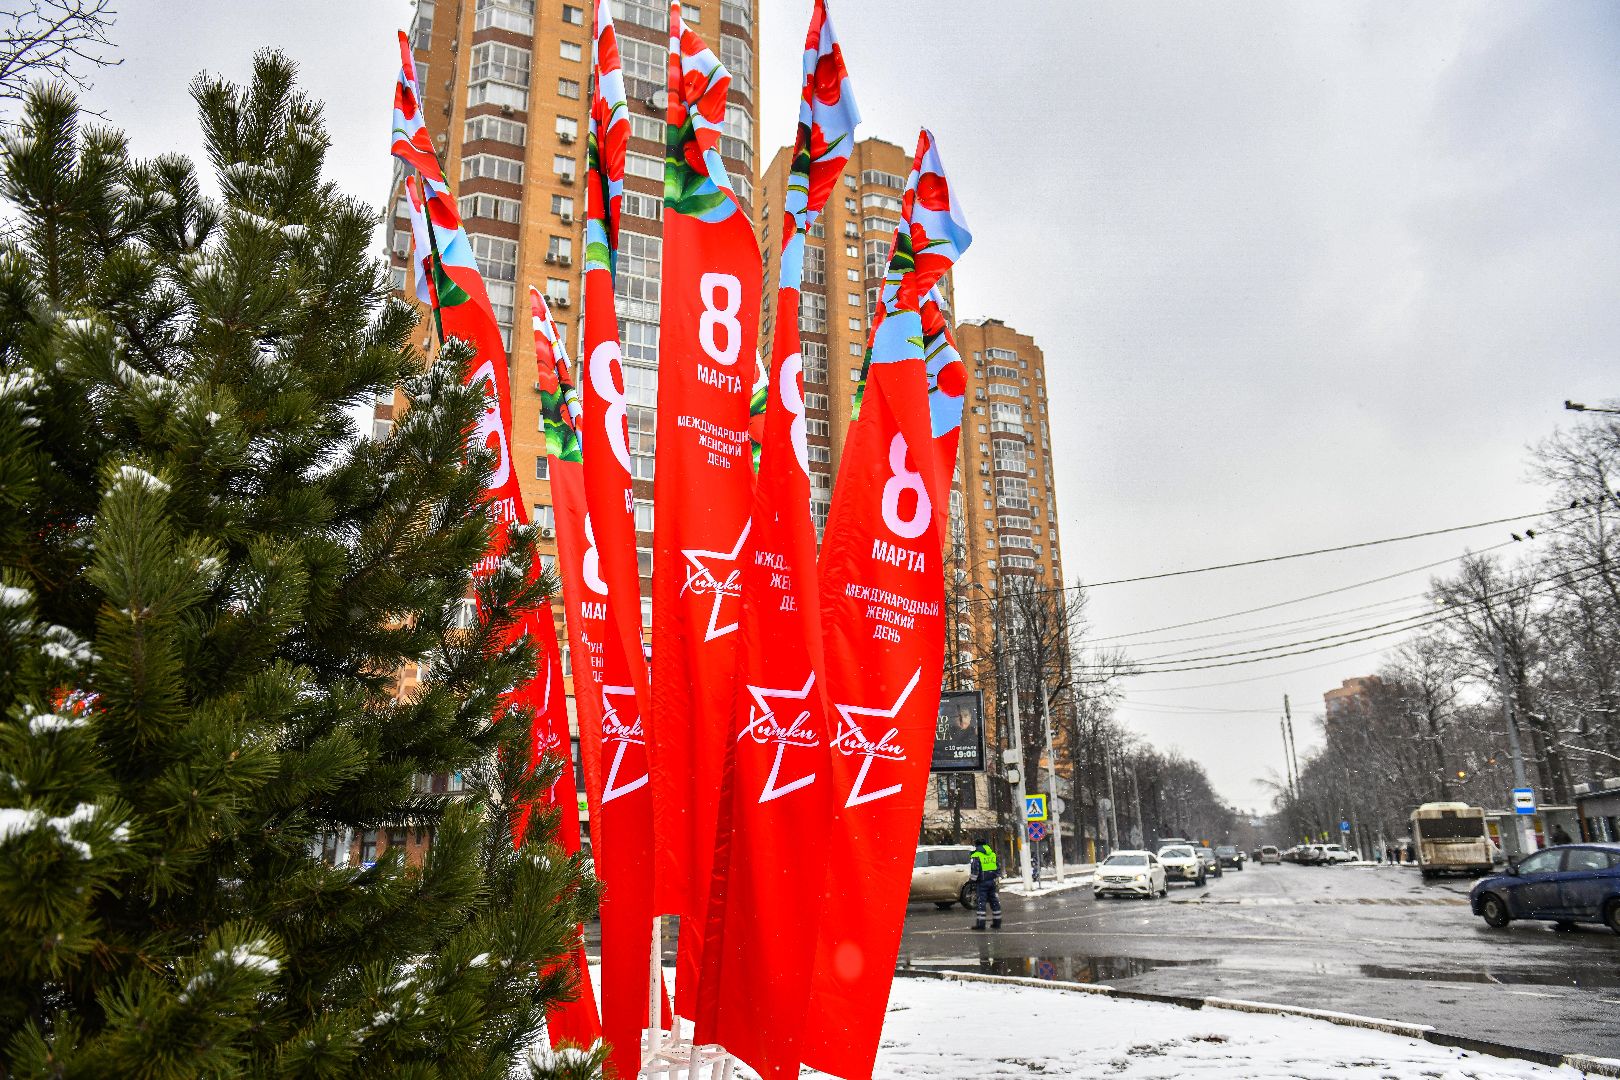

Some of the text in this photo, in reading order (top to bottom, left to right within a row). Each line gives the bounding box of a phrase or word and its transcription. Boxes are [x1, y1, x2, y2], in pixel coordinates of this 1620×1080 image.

[699, 272, 742, 366] 8
[697, 363, 742, 394] МАРТА
[677, 415, 751, 444] МЕЖДУНАРОДН
[698, 433, 742, 457] ЖЕНСКИЙ
[707, 452, 731, 469] ДЕНЬ
[881, 431, 932, 539] 8
[871, 538, 925, 573] МАРТА
[845, 582, 939, 616] МЕЖДУНАРОДНЫЙ
[865, 604, 915, 630] ЖЕНСКИЙ
[873, 624, 901, 643] ДЕНЬ
[737, 704, 819, 747] Химки
[829, 721, 907, 761] Химки
[953, 750, 977, 758] 19:00
